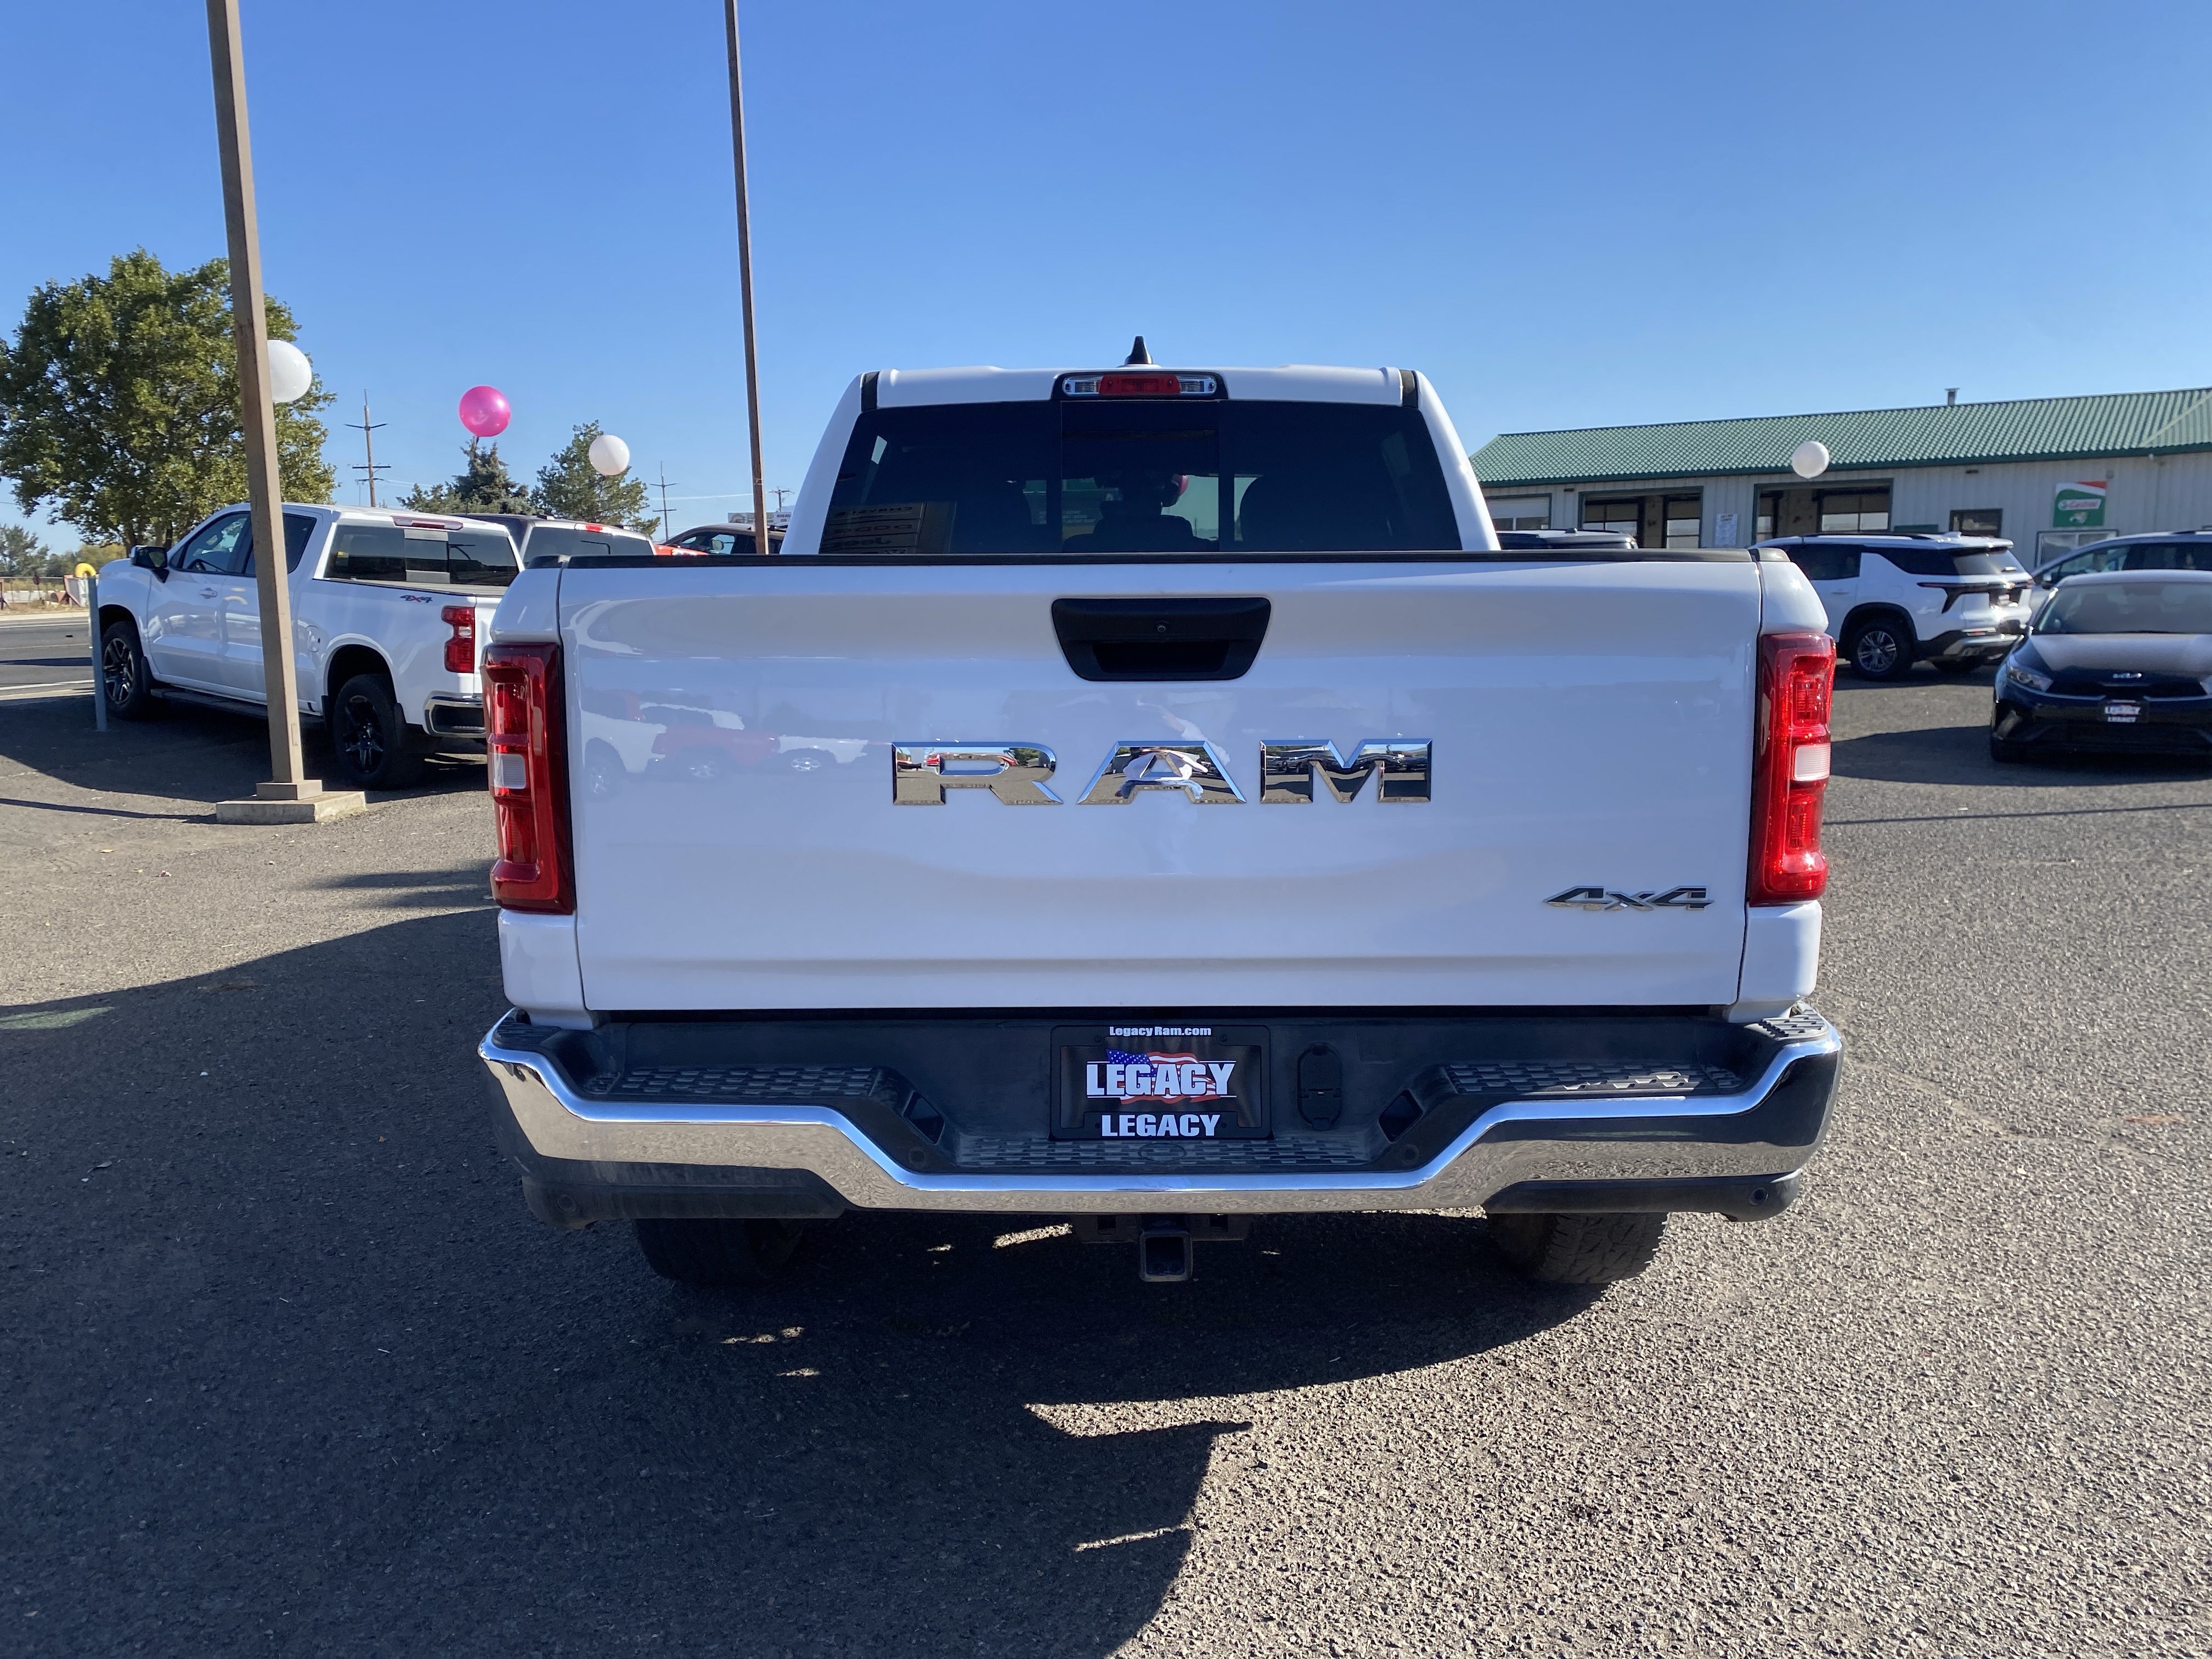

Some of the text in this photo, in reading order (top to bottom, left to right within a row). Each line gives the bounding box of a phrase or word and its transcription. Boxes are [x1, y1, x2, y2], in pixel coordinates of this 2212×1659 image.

[891, 738, 1433, 805] RAM
[1087, 1063, 1235, 1096] LEGACY
[1102, 1114, 1221, 1136] LEGACY
